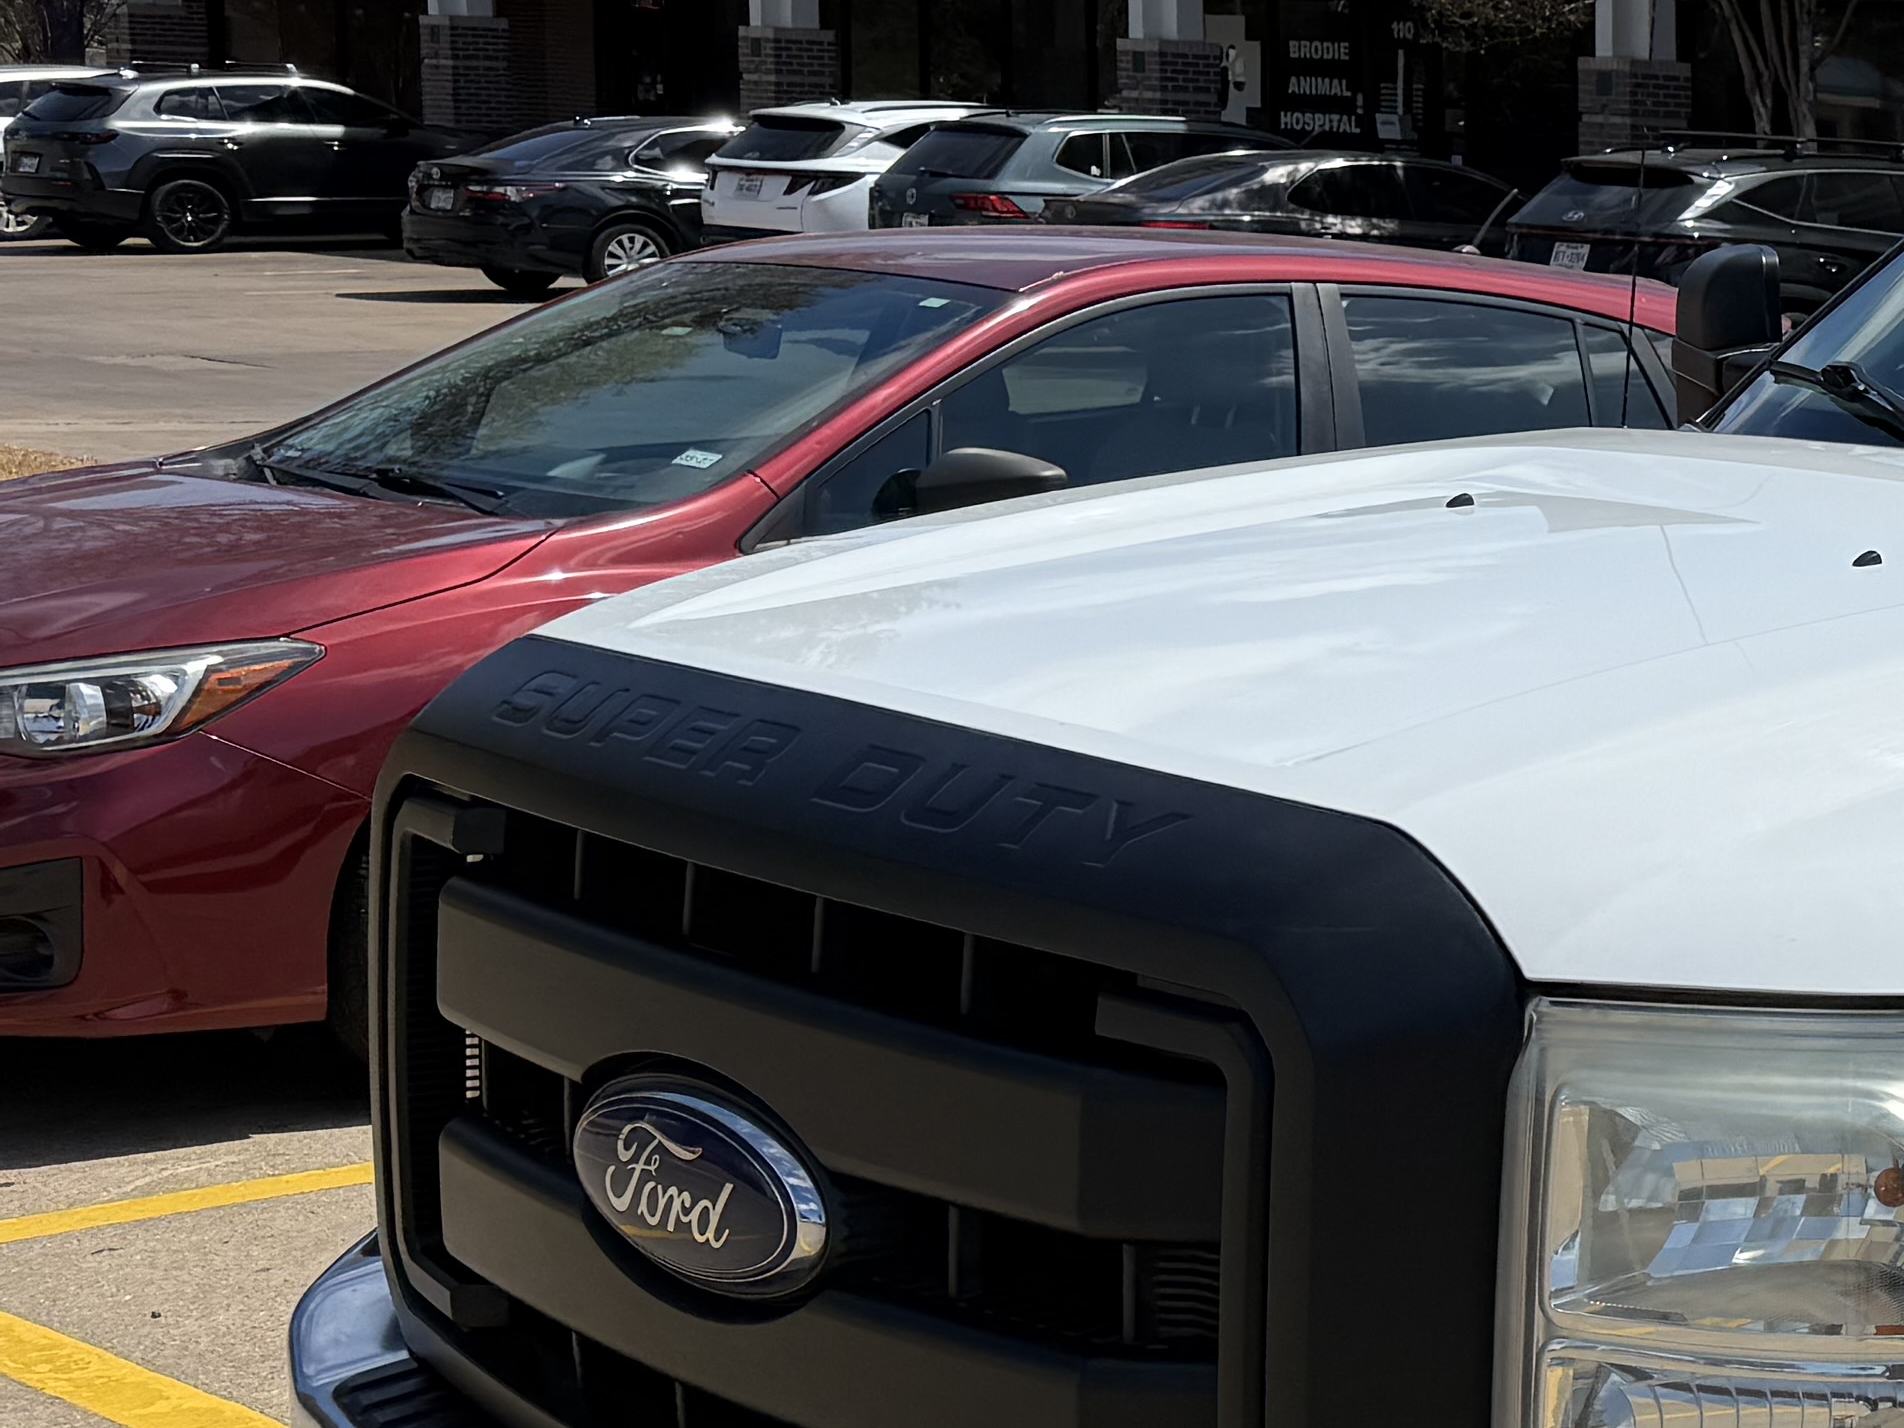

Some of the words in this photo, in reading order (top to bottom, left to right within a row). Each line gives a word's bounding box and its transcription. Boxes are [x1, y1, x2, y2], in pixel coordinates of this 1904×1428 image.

[1289, 40, 1350, 60] BRODIE
[1288, 76, 1352, 97] ANIMAL
[1280, 111, 1361, 133] HOSPITAL
[490, 669, 802, 786] SUPER
[811, 743, 1194, 867] DUTY
[605, 1122, 735, 1249] Ford
